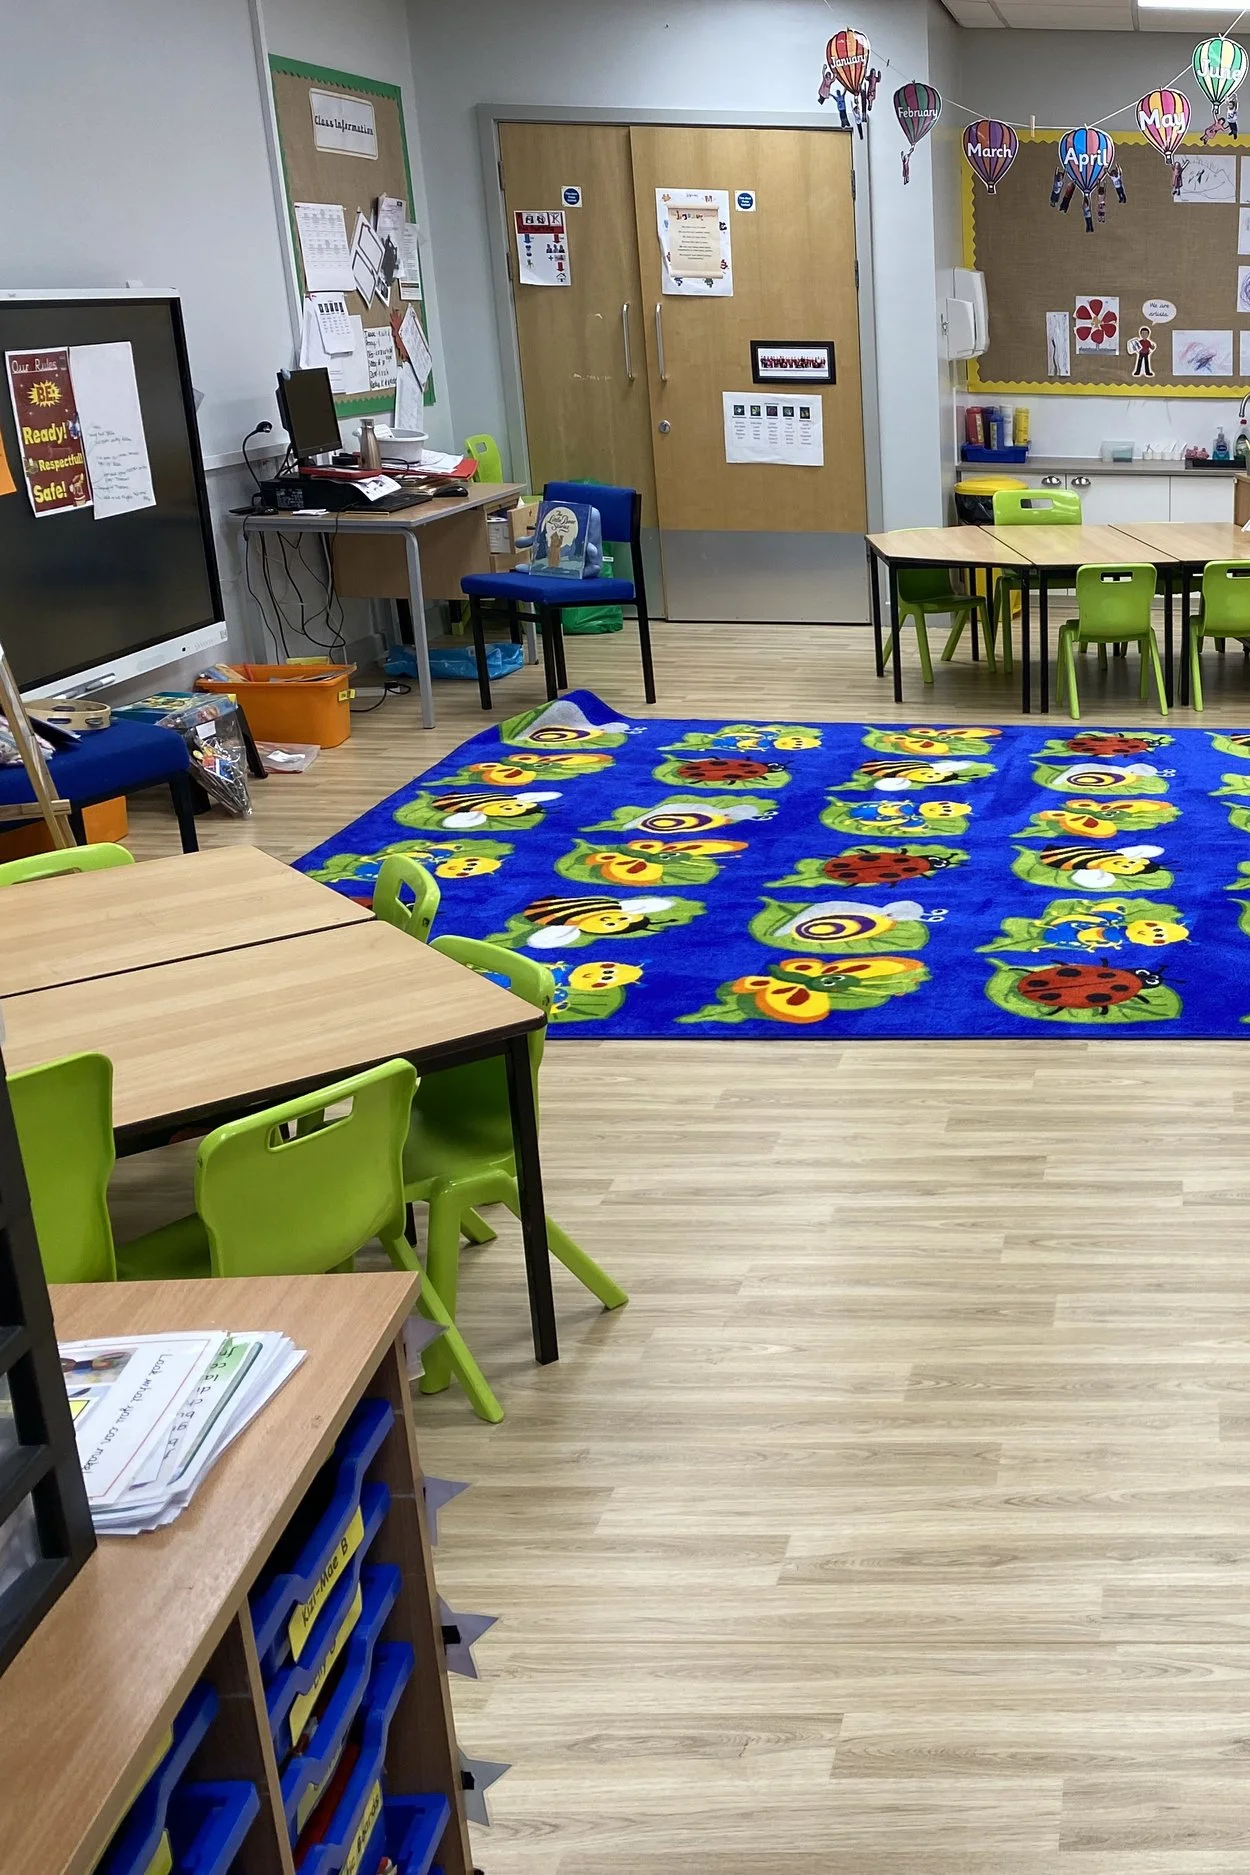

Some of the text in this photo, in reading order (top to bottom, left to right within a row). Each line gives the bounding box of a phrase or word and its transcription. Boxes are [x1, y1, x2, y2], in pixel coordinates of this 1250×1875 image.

[830, 53, 867, 68] January
[1197, 60, 1242, 81] June
[898, 107, 938, 121] February
[1139, 110, 1185, 133] May
[314, 115, 374, 135] Class Information
[967, 142, 1013, 158] March
[1064, 148, 1109, 168] April
[11, 358, 57, 374] Our Rules
[22, 422, 67, 445] Ready!
[38, 452, 84, 471] Respectful!
[33, 480, 68, 503] Safe!
[148, 1353, 173, 1377] Look
[131, 1378, 152, 1402] what
[116, 1404, 134, 1424] you
[100, 1426, 119, 1445] can
[301, 1537, 349, 1627] Kizi-Mae B
